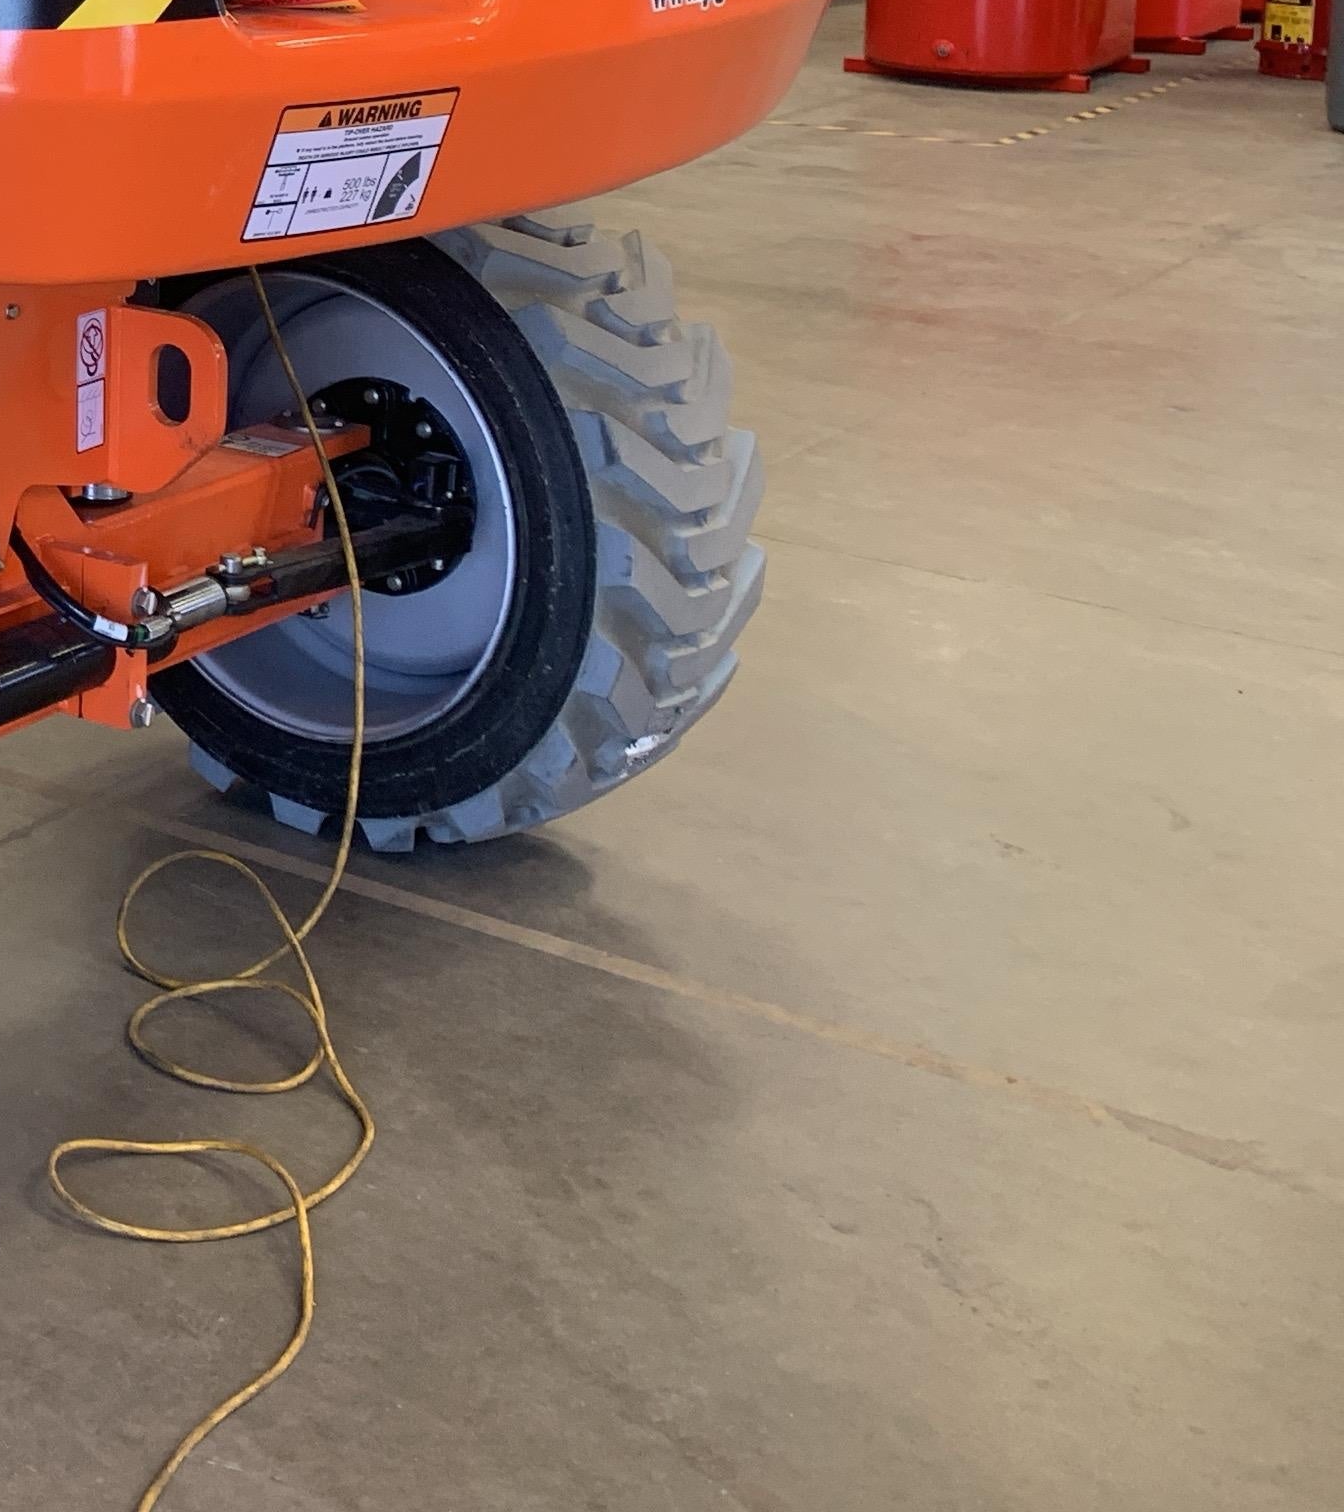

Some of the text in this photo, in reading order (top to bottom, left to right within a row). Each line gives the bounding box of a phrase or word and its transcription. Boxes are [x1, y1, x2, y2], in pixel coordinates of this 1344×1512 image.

[337, 99, 423, 127] WARNING
[342, 176, 377, 190] 500 lbs
[339, 190, 360, 203] 227
